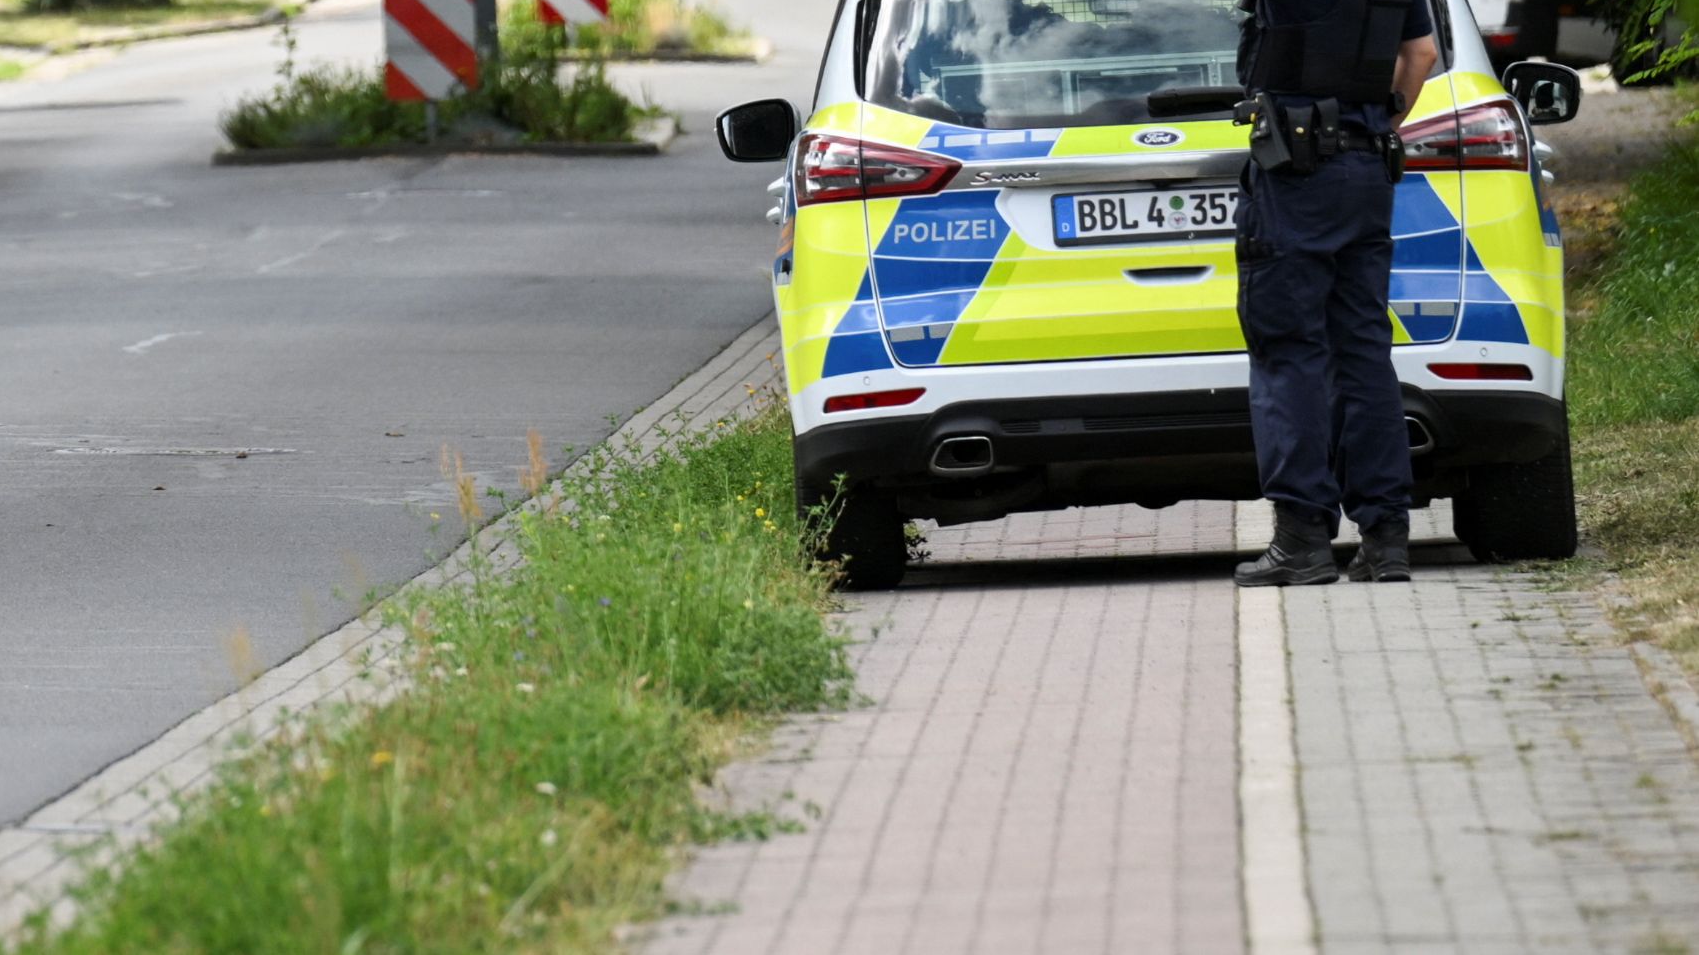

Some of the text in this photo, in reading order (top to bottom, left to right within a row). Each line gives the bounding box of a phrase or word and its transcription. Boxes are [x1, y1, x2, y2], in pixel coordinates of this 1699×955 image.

[1144, 132, 1171, 143] Ford
[1078, 198, 1139, 232] BBL
[1147, 196, 1165, 228] 4
[894, 219, 997, 244] POLIZEI
